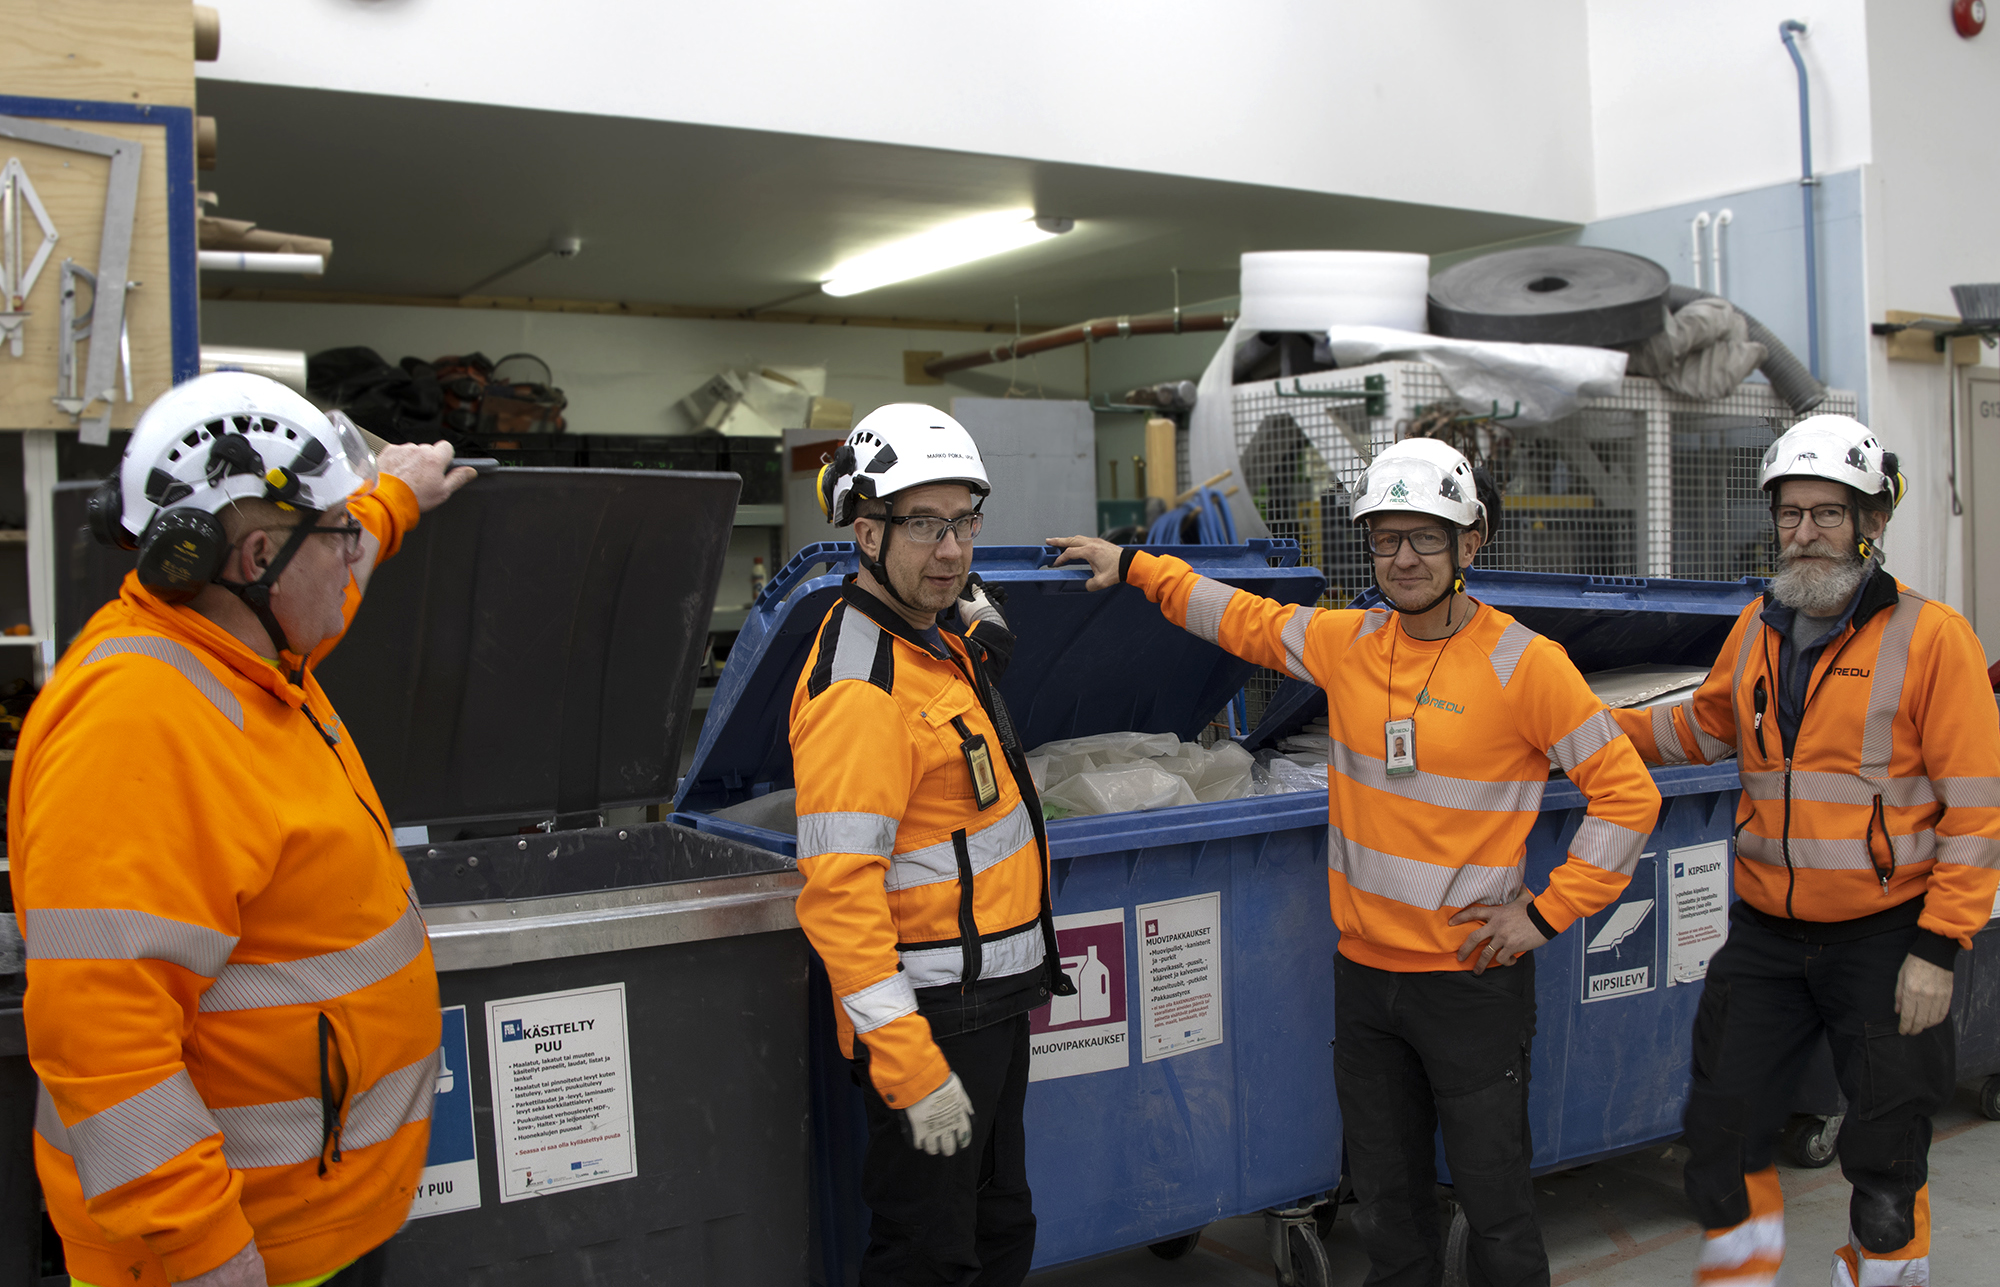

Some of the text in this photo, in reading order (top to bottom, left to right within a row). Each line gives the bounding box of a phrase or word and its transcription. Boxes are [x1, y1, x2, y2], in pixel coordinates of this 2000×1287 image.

[1833, 668, 1870, 678] REDU
[1429, 698, 1465, 714] REDU
[1688, 862, 1721, 876] KIPSILEVY
[1146, 927, 1211, 946] MUOVIPAKKAUKSET
[1152, 945, 1183, 955] Muovipullot,
[1159, 954, 1176, 963] -purkit
[1153, 962, 1184, 974] Muovikassit,
[1153, 973, 1173, 982] kääreet
[1180, 965, 1208, 976] kalvomuovi
[1154, 980, 1185, 992] Muovituubit,
[1592, 972, 1645, 992] KIPSILEVY
[1154, 990, 1190, 1002] Pakkausstyrox
[523, 1019, 595, 1040] KÄSITELTY
[535, 1040, 562, 1054] PUU
[1032, 1033, 1126, 1055] MUOVIPAKKAUKSET
[513, 1060, 540, 1068] Maalatut,
[513, 1067, 540, 1075] käsitellyt
[541, 1063, 566, 1072] paneelit,
[514, 1083, 540, 1091] Maalatut
[550, 1076, 583, 1086] pinnoitetut
[565, 1081, 602, 1091] puukuitulevy
[516, 1096, 557, 1108] Parkettilaudat
[585, 1087, 615, 1096] laminaatti-
[547, 1097, 593, 1109] korkkilattialevyt
[517, 1114, 553, 1124] Puukuituiset
[555, 1107, 592, 1118] verhouslevyt:
[567, 1113, 600, 1123] leijonalevyt
[518, 1125, 582, 1140] Huonekalujen puuosat
[570, 1136, 603, 1147] kyllästettyä
[428, 1180, 453, 1196] PUU
